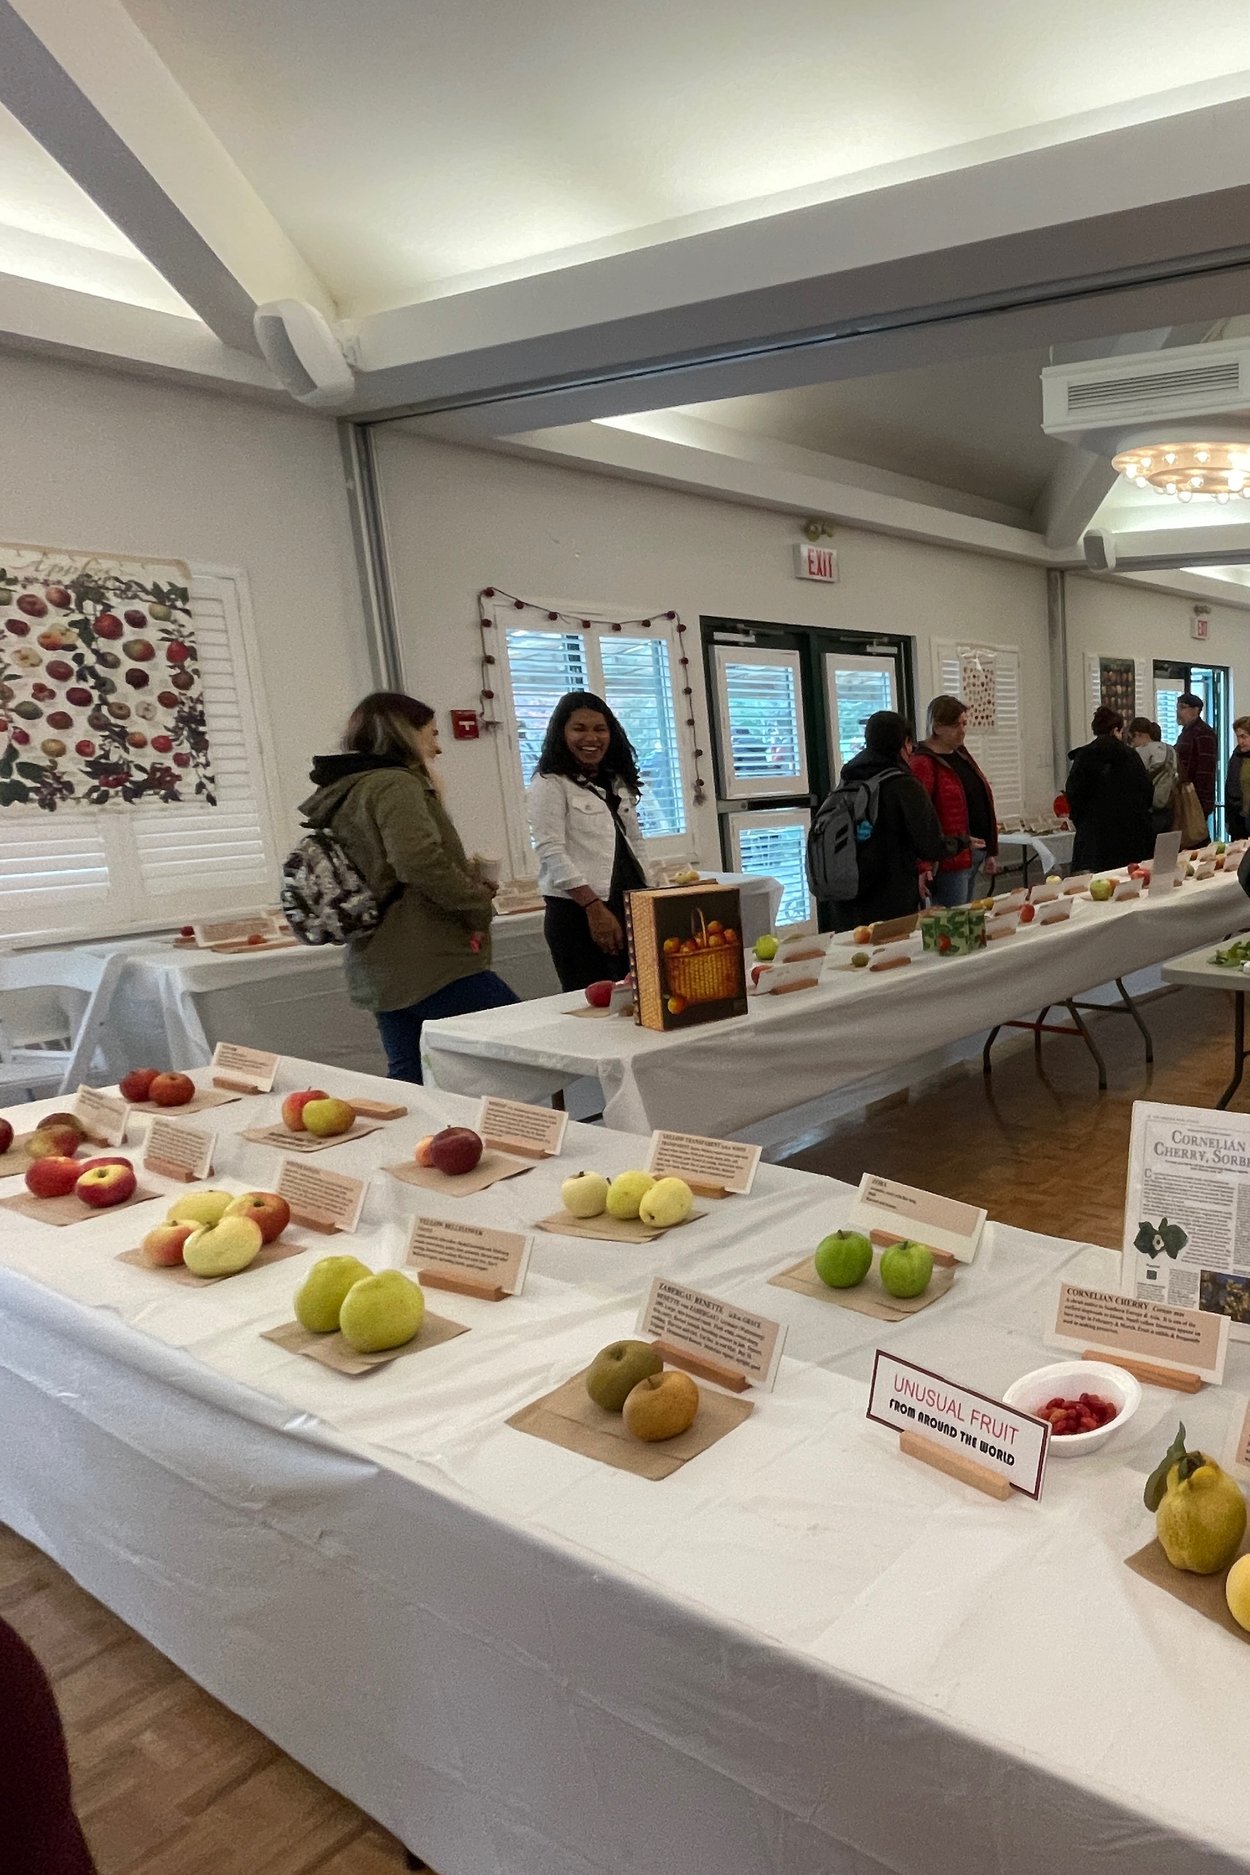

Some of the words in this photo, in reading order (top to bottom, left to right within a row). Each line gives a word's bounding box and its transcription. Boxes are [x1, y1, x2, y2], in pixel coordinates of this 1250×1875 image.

[807, 547, 833, 578] EXIT
[1171, 1130, 1246, 1152] CORNELIAN
[1066, 1287, 1112, 1303] CORNELIAN
[1114, 1297, 1147, 1310] CHERRY
[894, 1374, 965, 1422] UNUSUAL
[970, 1409, 1019, 1445] FRUIT
[889, 1398, 915, 1419] FROM
[917, 1411, 957, 1438] AROUND
[960, 1431, 977, 1448] THE
[980, 1440, 1015, 1466] WORLD
